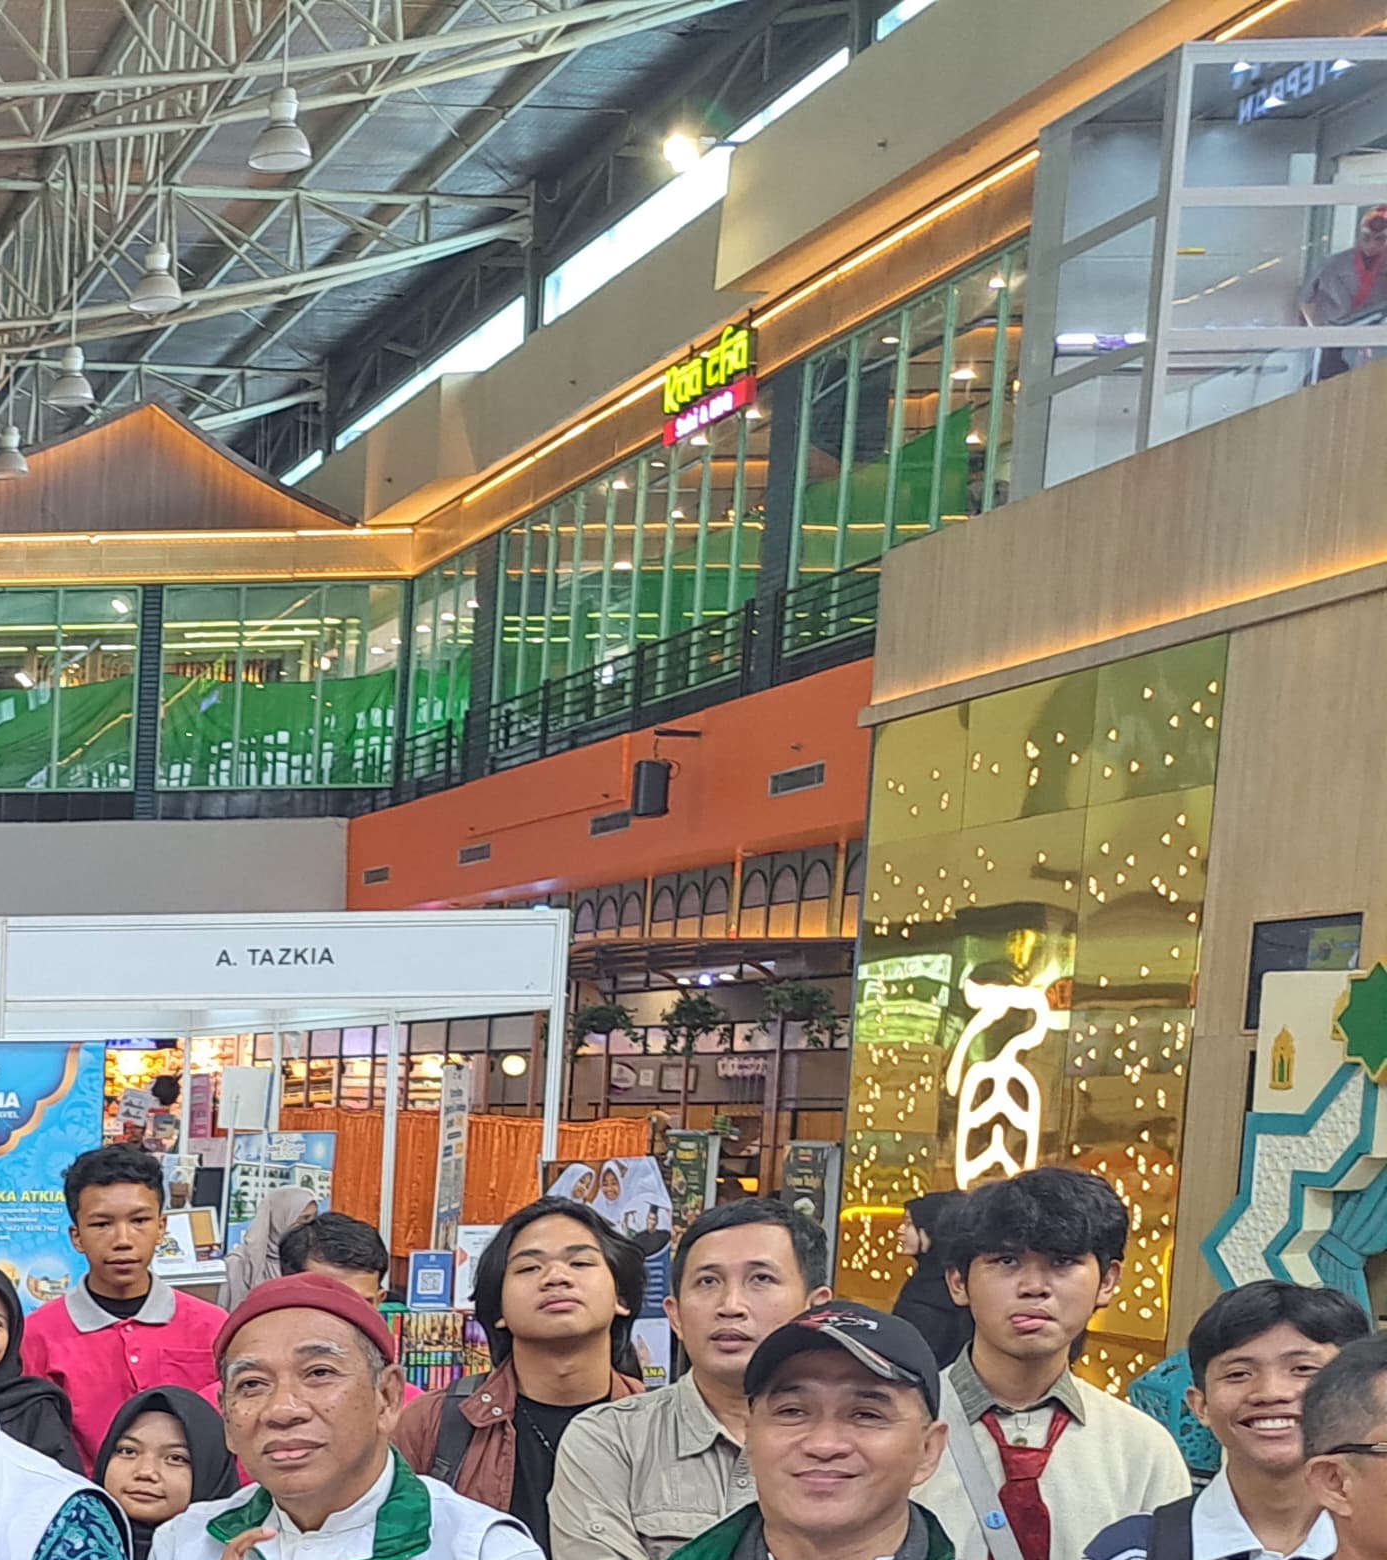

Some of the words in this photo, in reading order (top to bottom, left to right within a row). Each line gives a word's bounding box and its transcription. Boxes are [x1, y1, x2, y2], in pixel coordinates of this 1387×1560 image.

[215, 949, 237, 966] A.
[247, 947, 335, 966] TAZKIA
[21, 1190, 66, 1202] ATKIA
